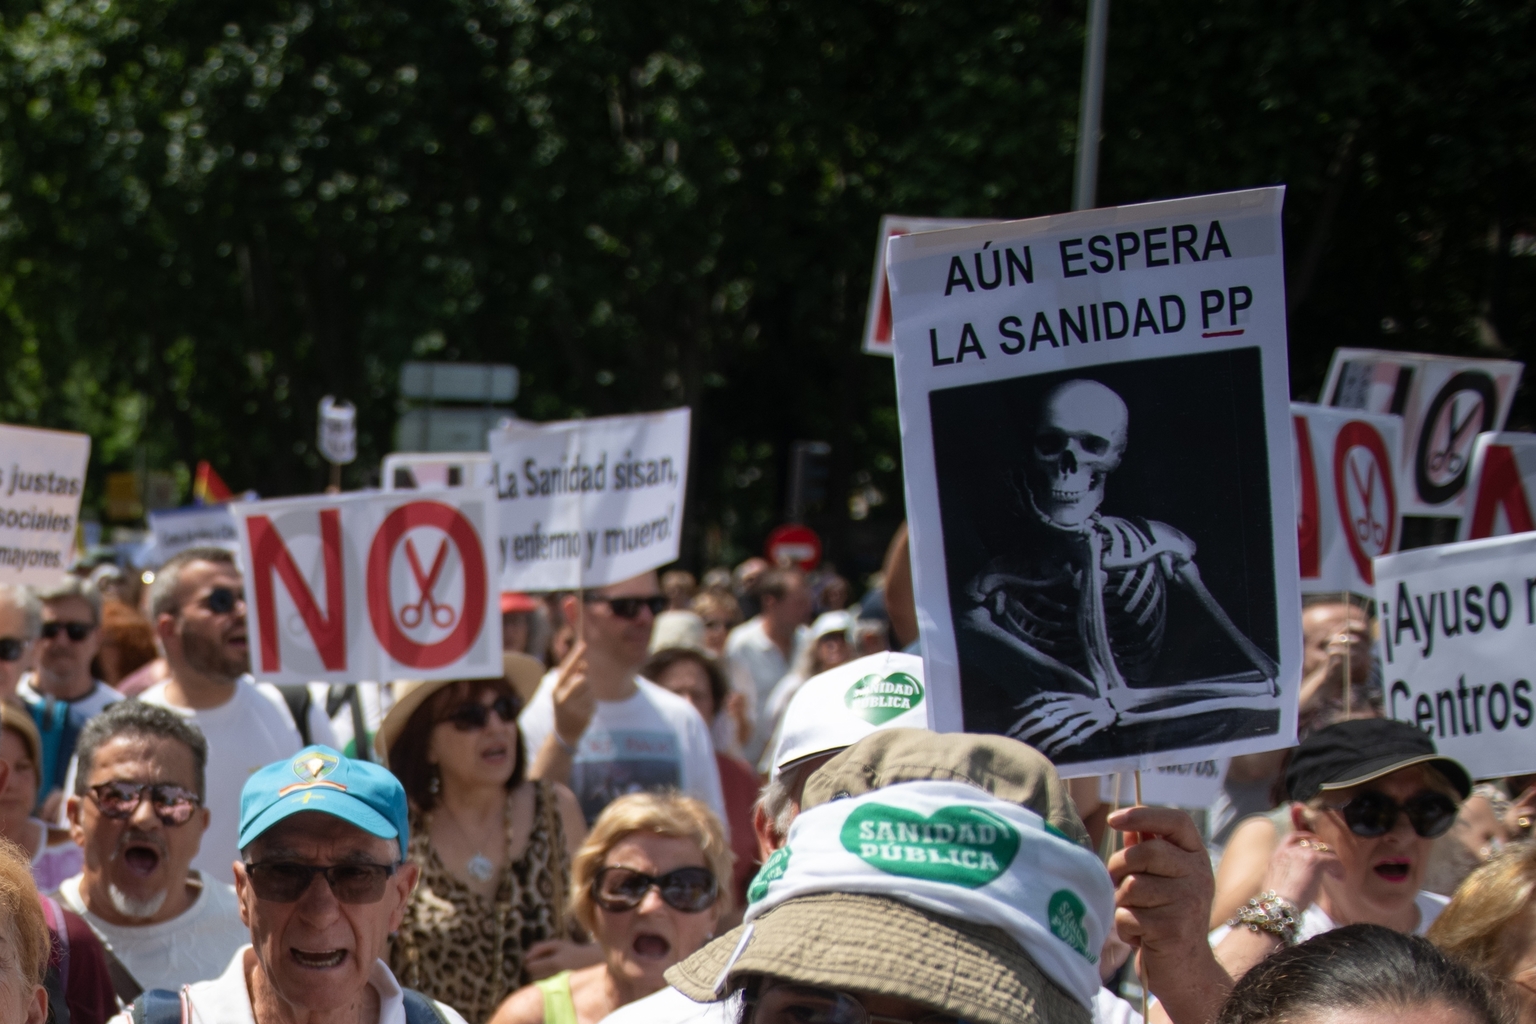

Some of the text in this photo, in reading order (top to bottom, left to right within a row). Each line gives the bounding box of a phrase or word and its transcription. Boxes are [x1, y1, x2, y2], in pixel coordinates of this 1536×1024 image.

[944, 219, 1232, 296] AÚN ESPERA
[929, 285, 1253, 367] LA SANIDAD PP
[7, 463, 80, 496] justas
[524, 452, 607, 496] Sanidad
[615, 449, 678, 490] sisan,
[499, 536, 509, 574] y
[513, 521, 581, 561] enfermo
[585, 530, 597, 569] y
[246, 500, 488, 672] NO
[1382, 581, 1514, 664] ¡Ayuso
[1391, 674, 1535, 738] Centros
[859, 820, 997, 845] SANIDAD
[859, 841, 1000, 871] PÚBLICA
